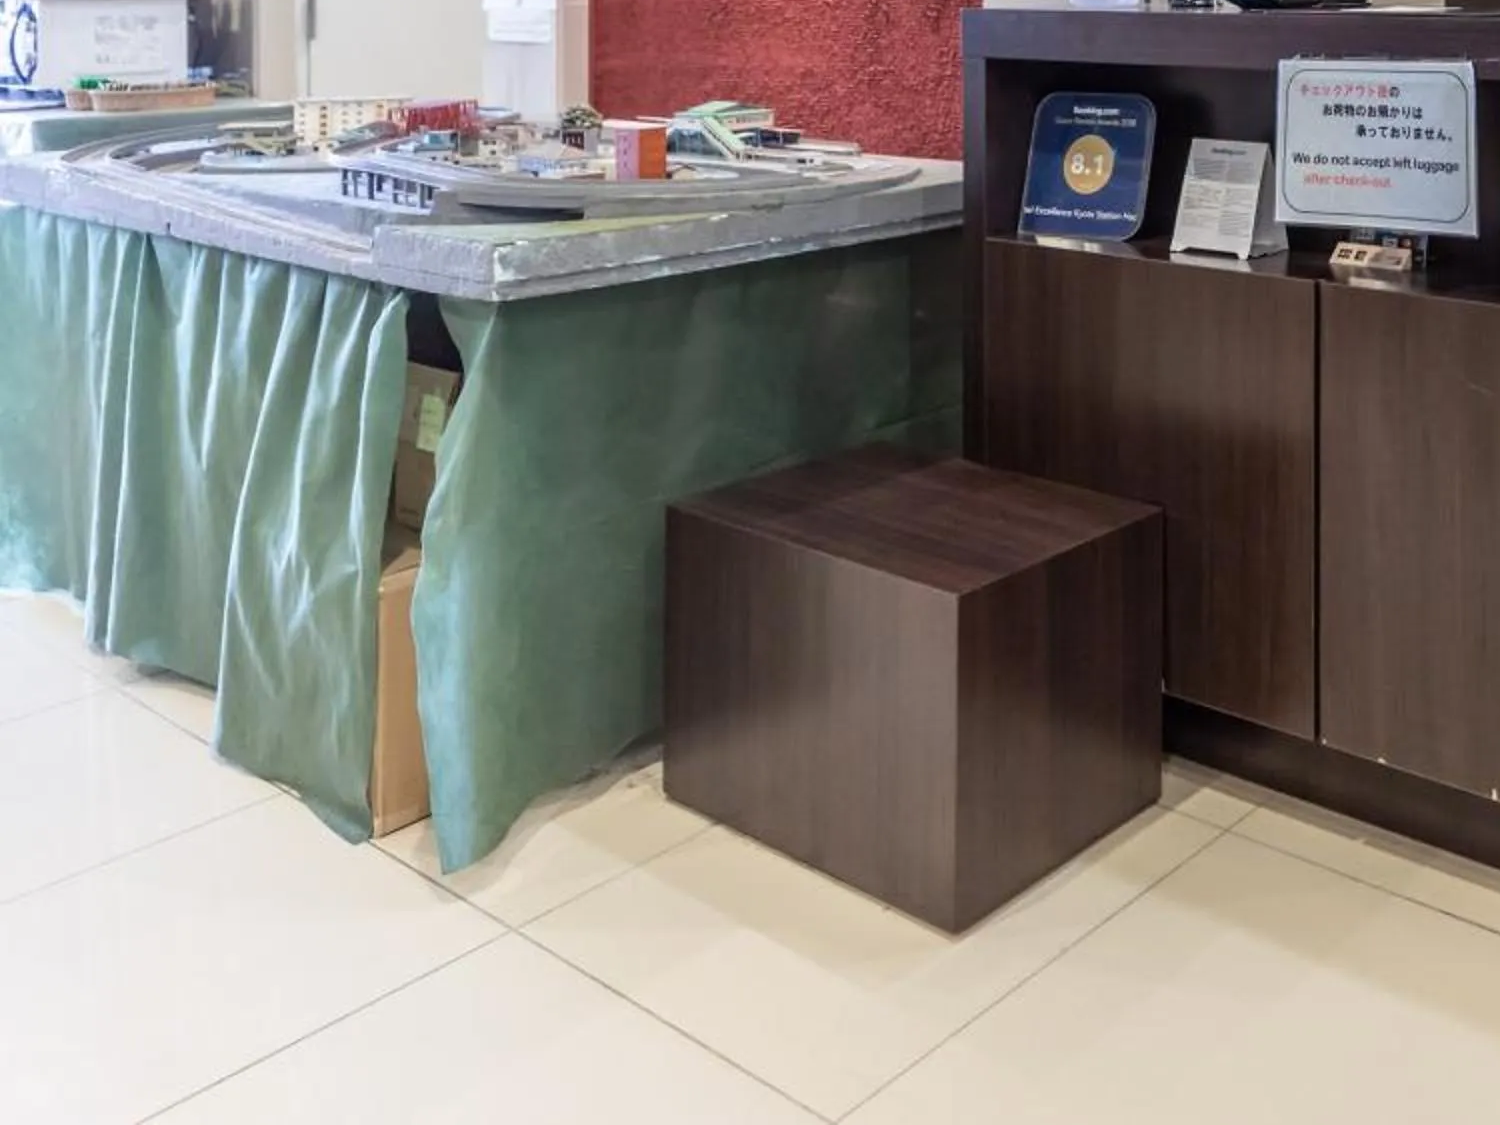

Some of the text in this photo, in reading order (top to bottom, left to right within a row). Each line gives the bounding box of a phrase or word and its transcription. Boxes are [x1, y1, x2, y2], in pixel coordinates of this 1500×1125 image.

[1300, 84, 1400, 98] チェックアウト後の
[1322, 103, 1423, 120] お荷物のお預かりは
[1355, 124, 1453, 142] 承っておりません。
[1071, 153, 1104, 175] 8.1
[1292, 152, 1460, 174] We do not accept left luggage
[1304, 173, 1332, 186] after
